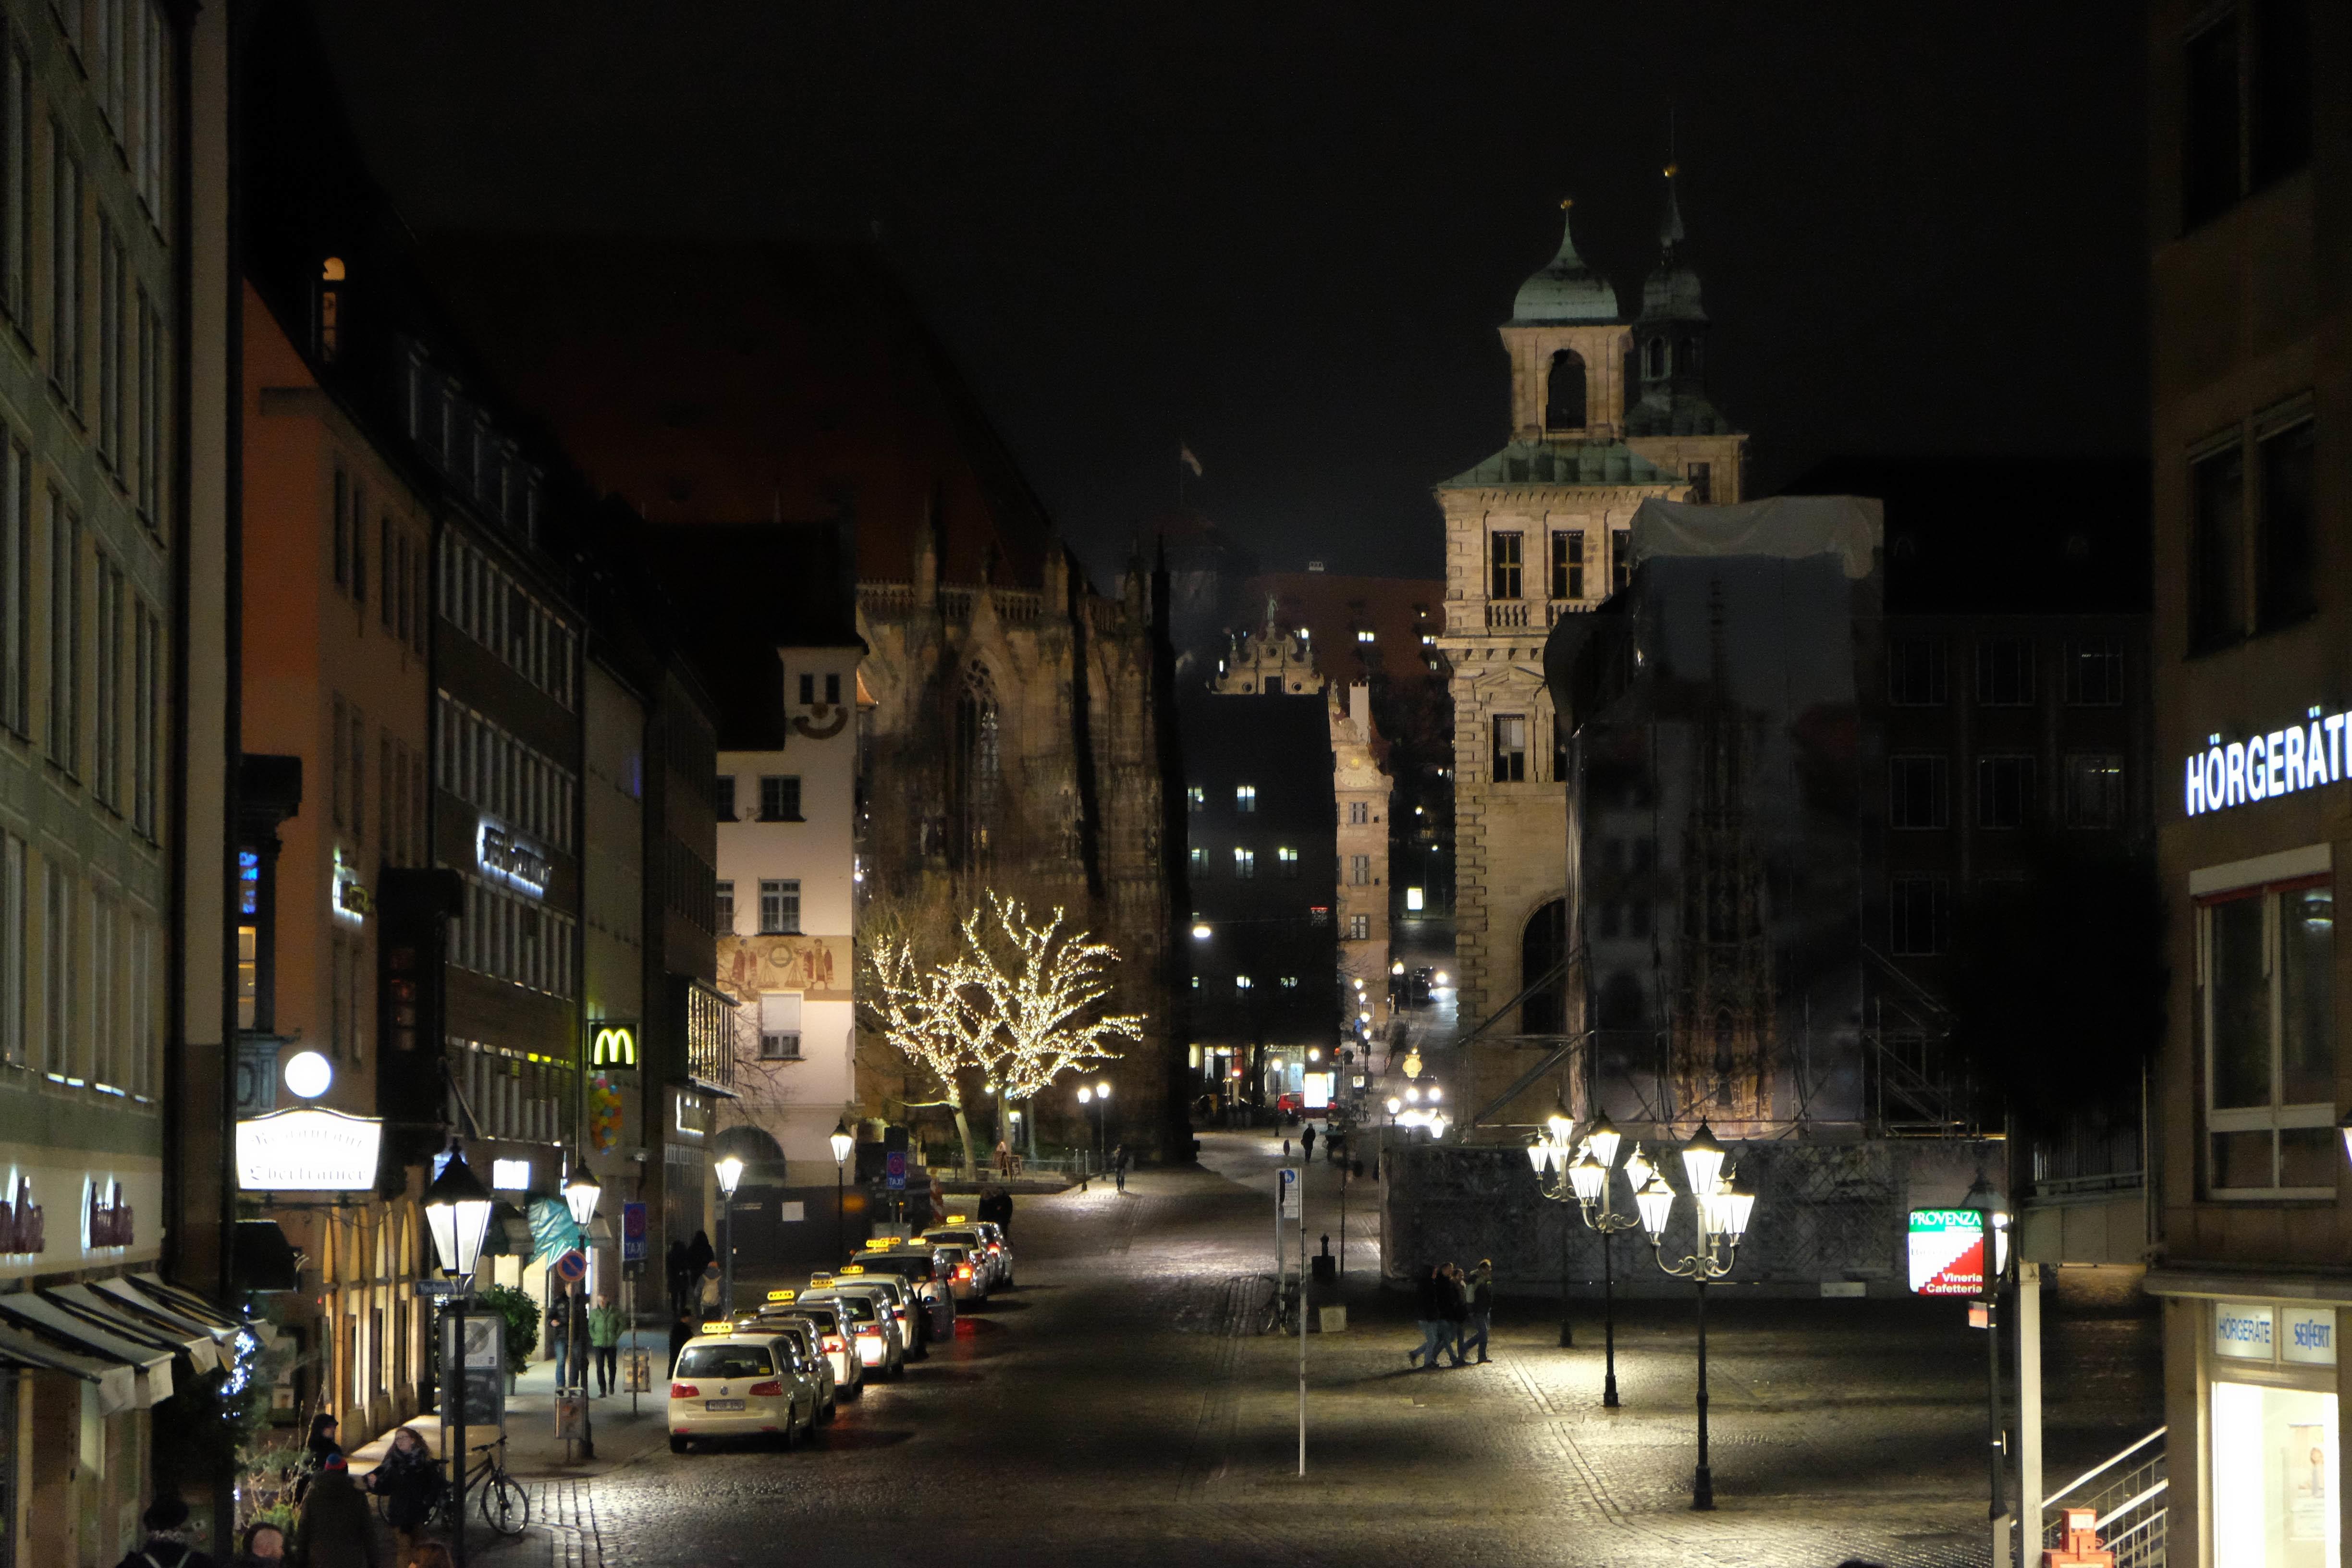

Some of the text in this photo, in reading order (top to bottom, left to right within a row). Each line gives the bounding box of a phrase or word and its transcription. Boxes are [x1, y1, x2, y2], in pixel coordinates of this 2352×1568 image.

[250, 1129, 362, 1149] Rtaurant
[889, 1178, 904, 1186] TAXI
[1911, 1212, 1981, 1225] PROVENZA
[626, 1241, 644, 1254] TAXI
[1942, 1273, 1982, 1282] Vineria
[1927, 1284, 1982, 1293] Cafetteria
[2218, 1313, 2271, 1344] HÖRGERÄTE
